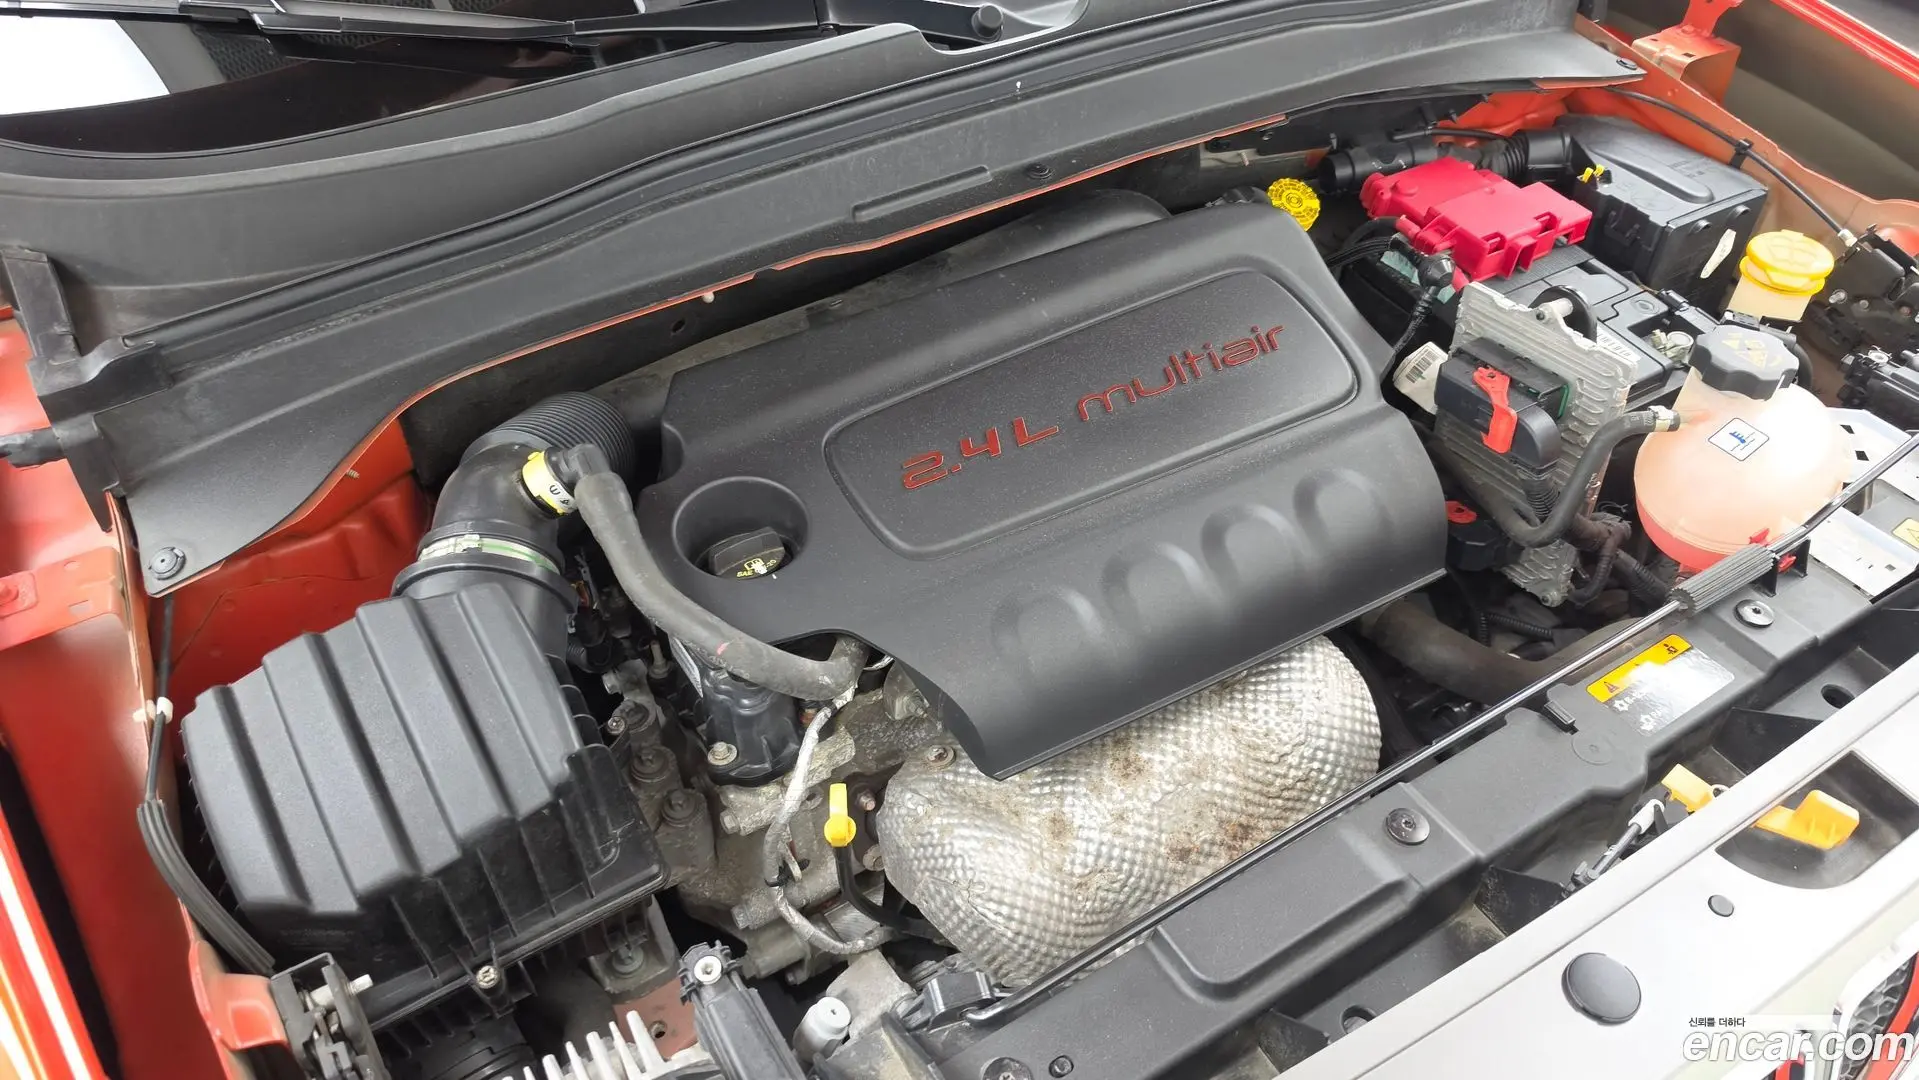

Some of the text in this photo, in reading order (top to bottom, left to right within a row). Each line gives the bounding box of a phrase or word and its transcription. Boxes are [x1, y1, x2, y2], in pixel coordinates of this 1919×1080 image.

[902, 324, 1284, 490] 2.4 L multiair
